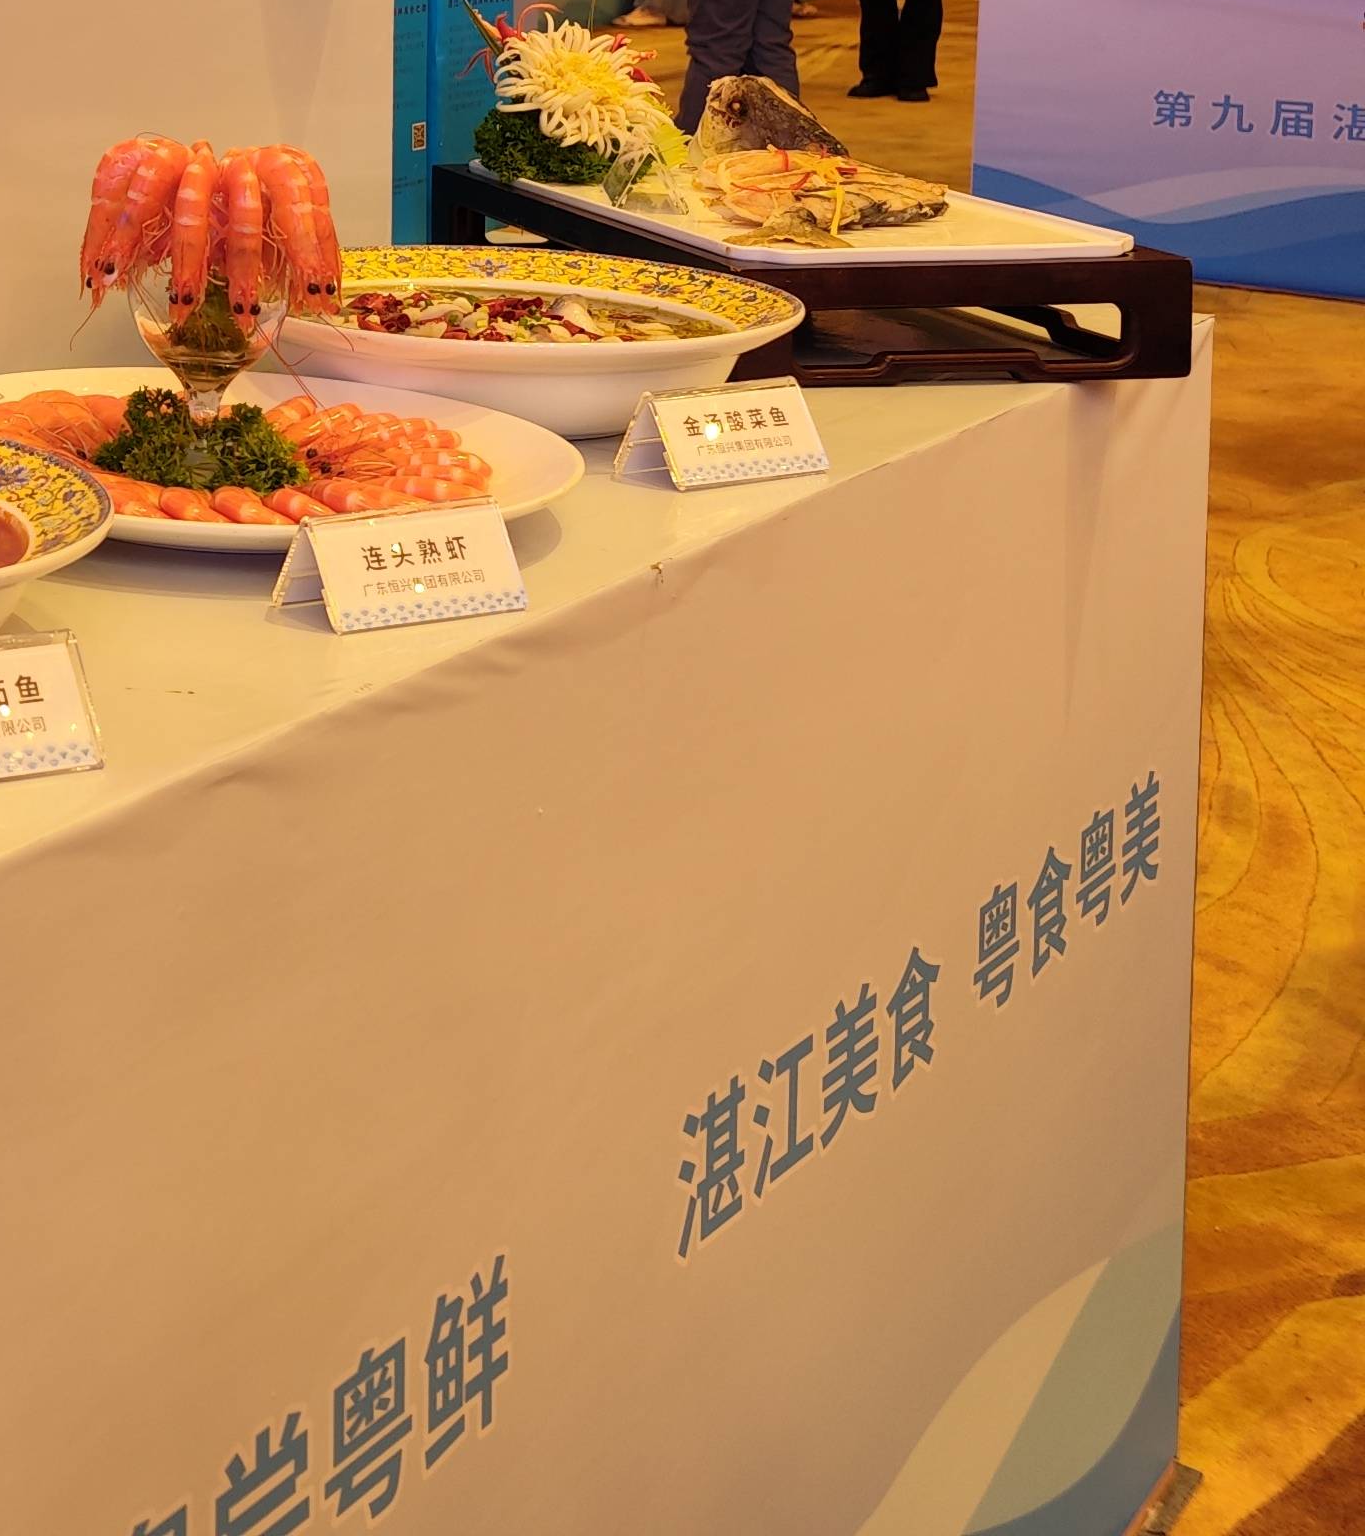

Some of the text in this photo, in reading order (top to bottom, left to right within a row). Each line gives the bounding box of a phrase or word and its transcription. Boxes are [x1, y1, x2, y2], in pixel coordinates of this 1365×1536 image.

[360, 536, 468, 572] 连头熟虾
[363, 569, 485, 597] 广东恒兴集团有限公司
[678, 771, 1162, 1258] 湛江美食 粤食粤美
[131, 1254, 508, 1536] 尝粤鲜
